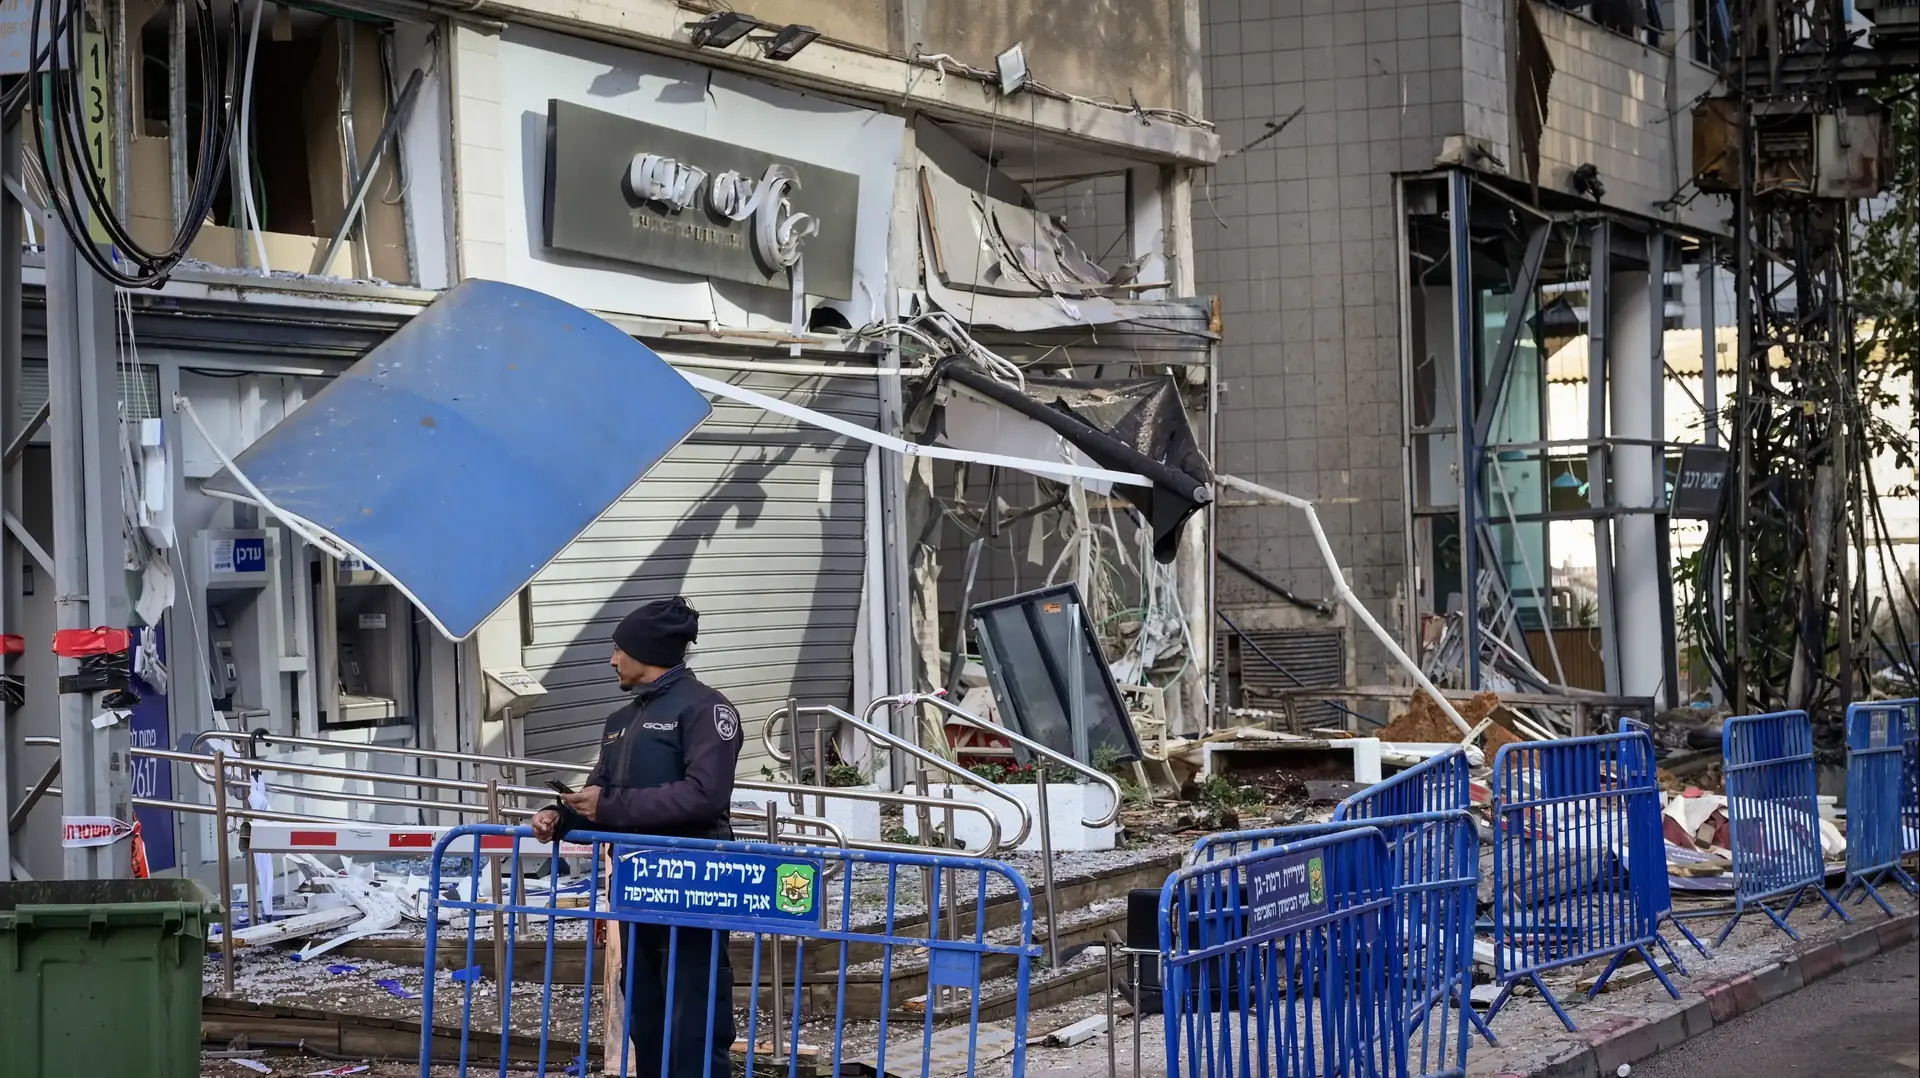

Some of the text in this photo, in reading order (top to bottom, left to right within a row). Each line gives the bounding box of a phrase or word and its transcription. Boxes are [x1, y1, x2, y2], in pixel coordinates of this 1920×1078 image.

[236, 546, 262, 565] עדכן
[138, 728, 157, 748] פתוח
[66, 823, 112, 840] משטרת
[632, 857, 767, 885] עיריית רמת-גן
[1253, 863, 1305, 902] עיריית רמת-גן
[624, 885, 771, 912] אגף הביטחון והאכיפה
